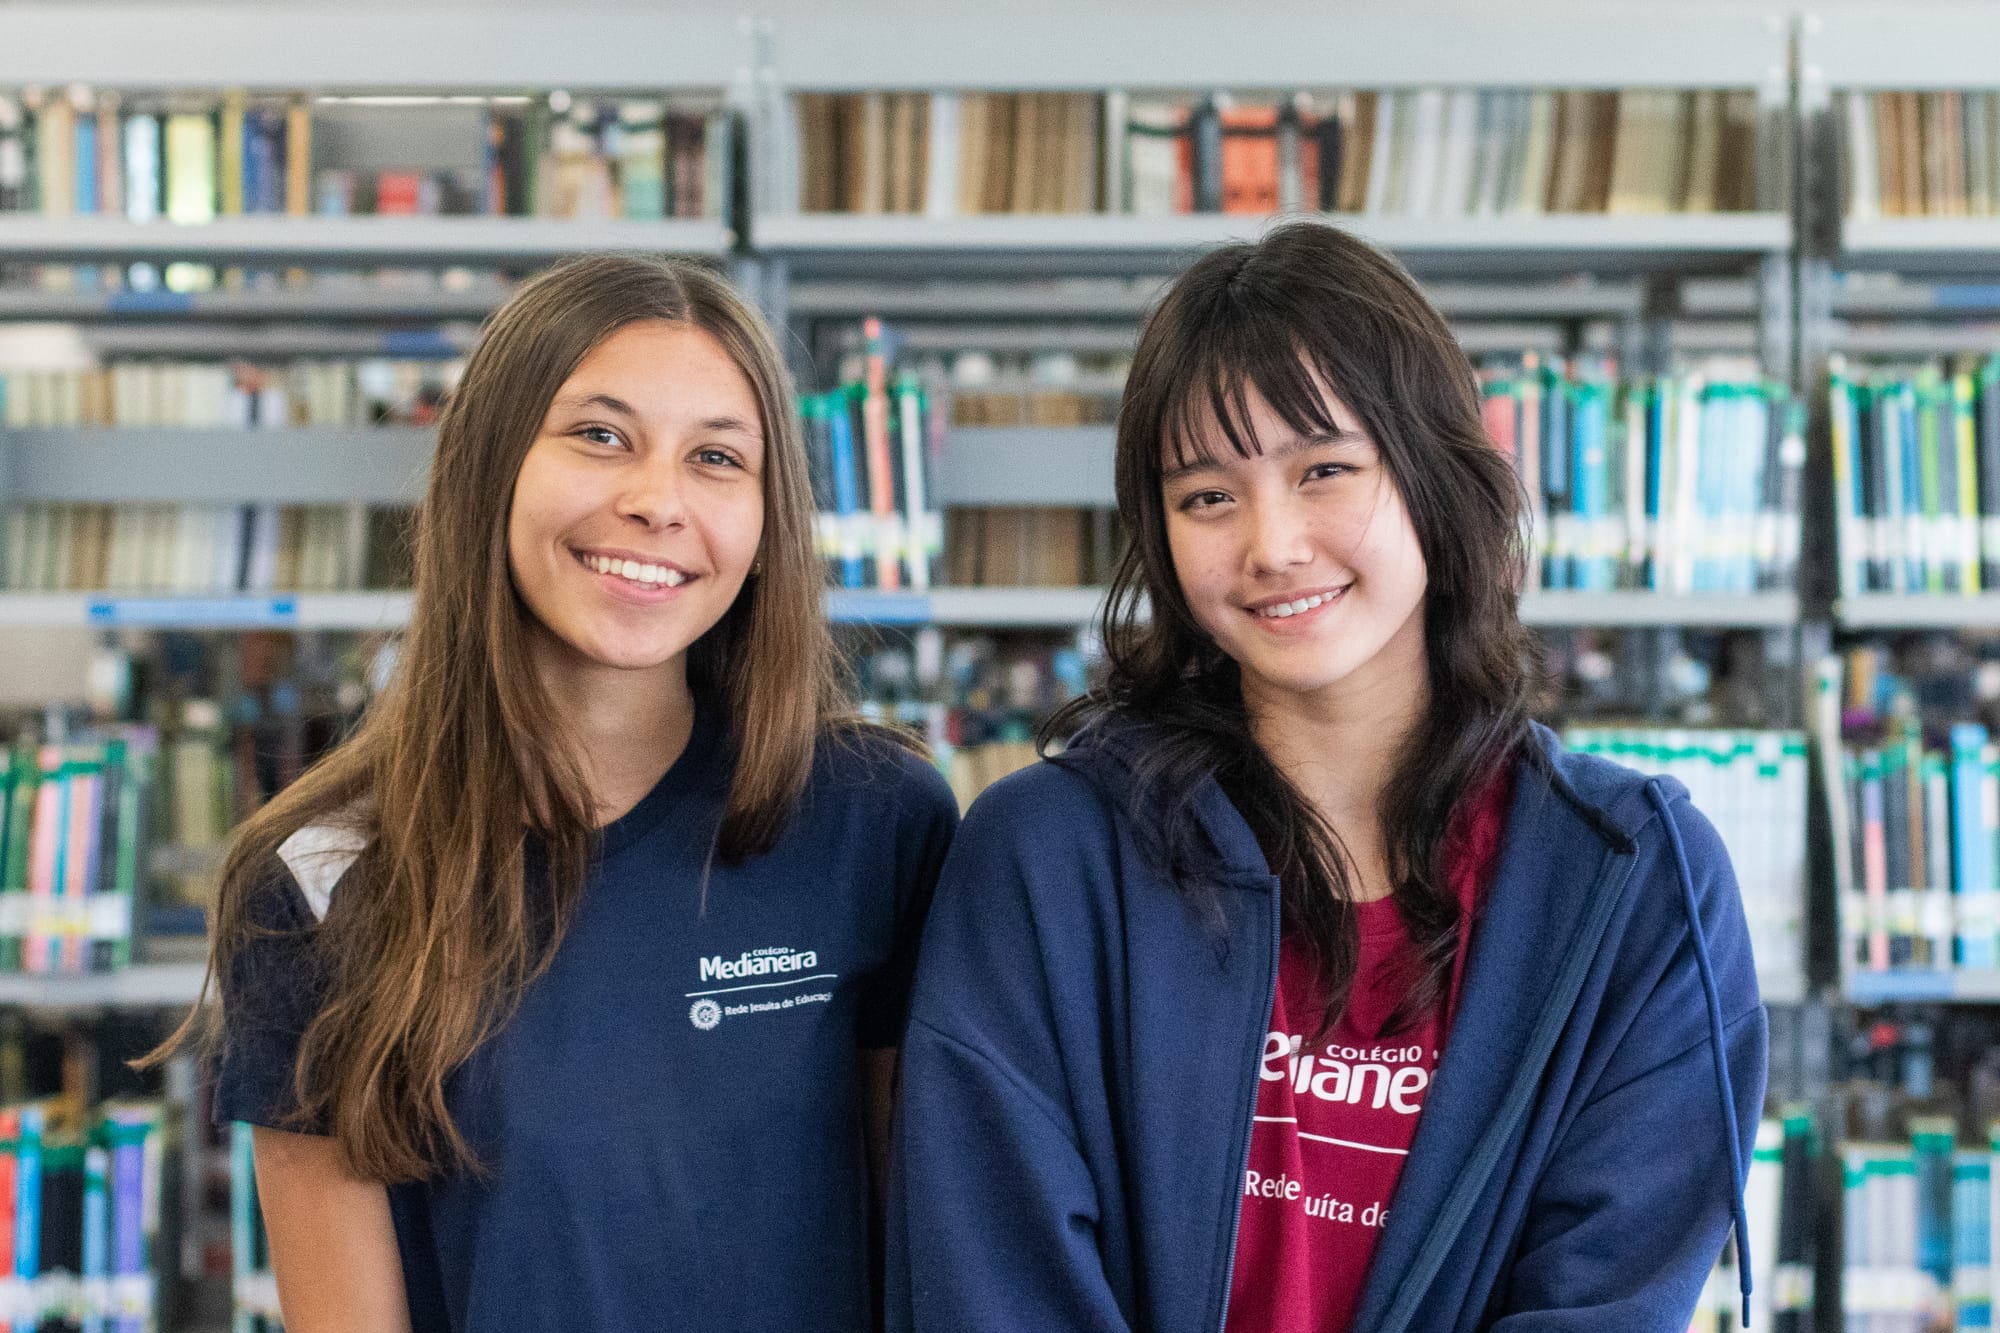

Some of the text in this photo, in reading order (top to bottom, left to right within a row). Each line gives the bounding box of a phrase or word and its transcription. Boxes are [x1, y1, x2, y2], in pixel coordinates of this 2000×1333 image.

[700, 948, 817, 981] Medianeira
[725, 1003, 749, 1016] Rede
[781, 999, 794, 1009] de
[1326, 1044, 1422, 1063] COLÉGIO
[1244, 1170, 1301, 1200] Rede
